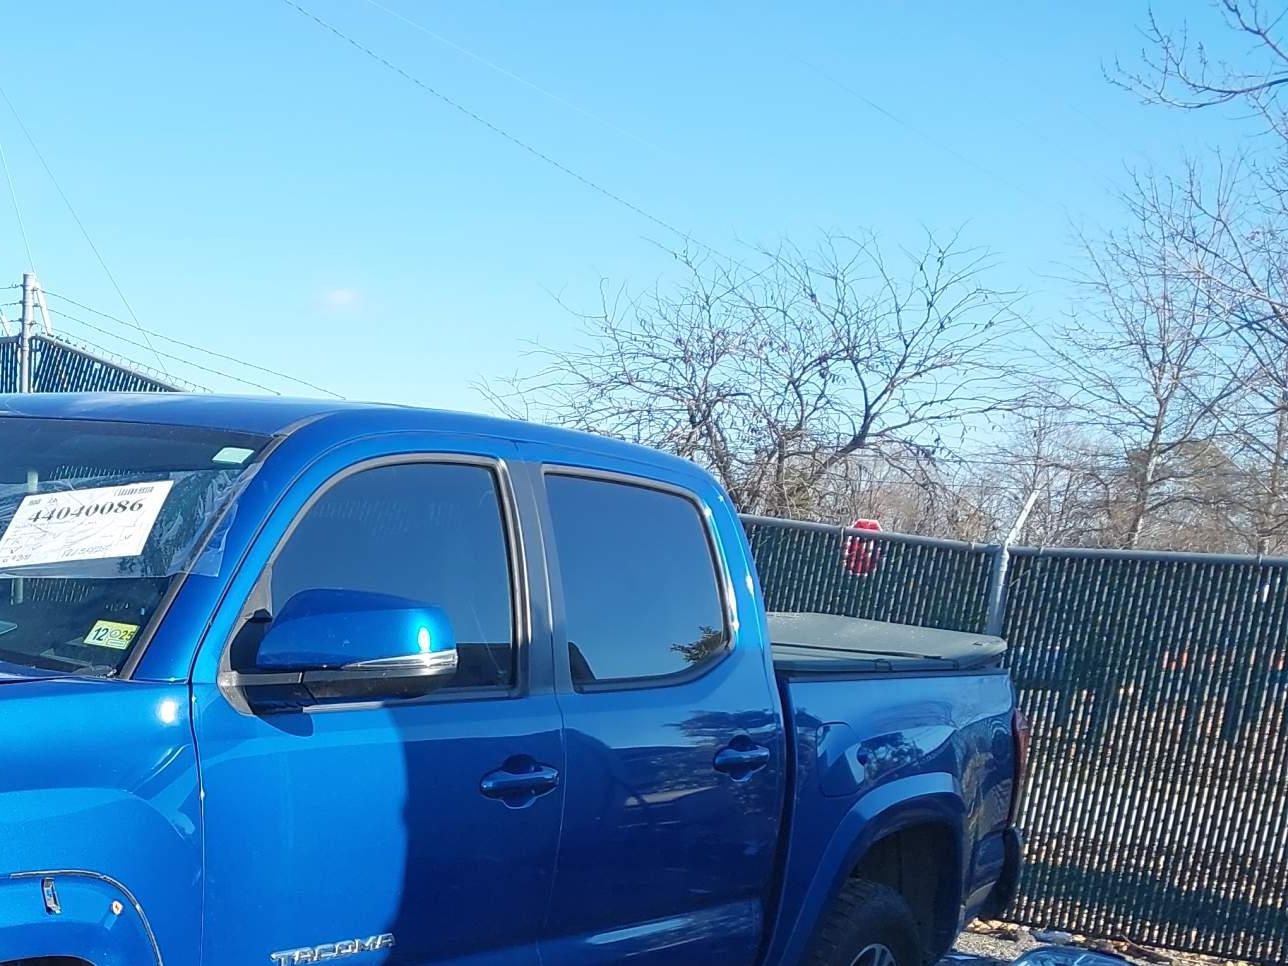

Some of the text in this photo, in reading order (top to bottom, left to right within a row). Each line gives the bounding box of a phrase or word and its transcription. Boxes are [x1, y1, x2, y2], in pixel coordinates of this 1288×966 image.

[28, 499, 145, 523] 44040086
[92, 627, 135, 641] 12 25
